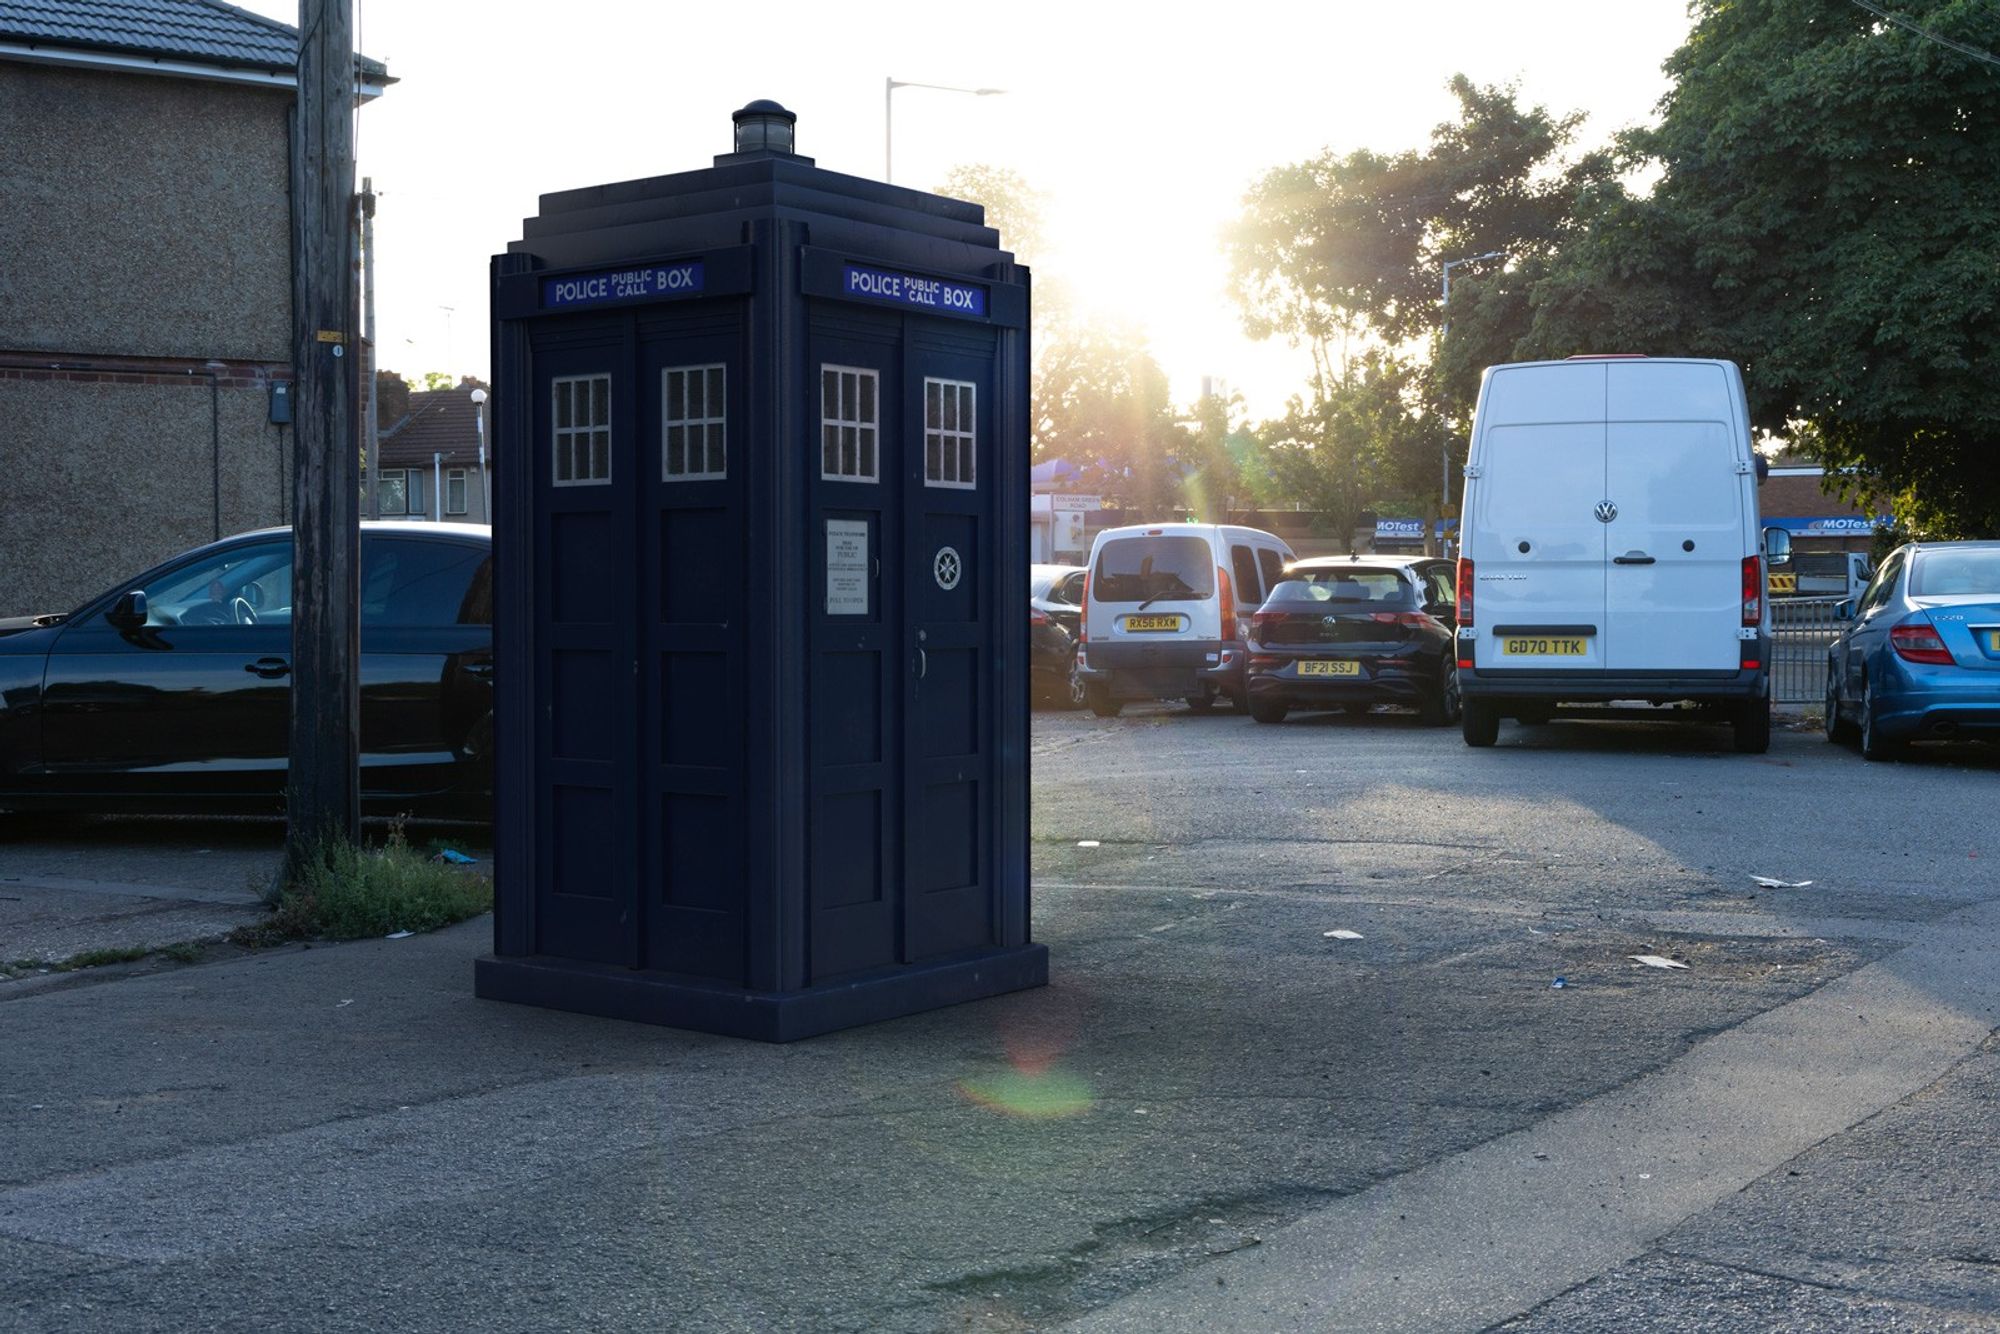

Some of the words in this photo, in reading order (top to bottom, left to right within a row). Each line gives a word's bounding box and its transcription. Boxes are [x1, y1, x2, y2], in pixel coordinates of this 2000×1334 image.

[611, 270, 652, 286] PUBLIC
[657, 267, 694, 290] BOX
[851, 271, 900, 297] POLICE
[904, 277, 939, 294] PUBLIC
[556, 278, 607, 301] POLICE
[616, 283, 647, 297] CALL
[908, 290, 936, 305] CALL
[943, 286, 973, 309] BOX
[1823, 519, 1877, 529] MOTest
[1130, 617, 1154, 628] RX56
[1509, 640, 1547, 654] GD70
[1552, 640, 1581, 654] TTK
[1304, 662, 1329, 673] BF21
[1331, 662, 1353, 674] SSJ
